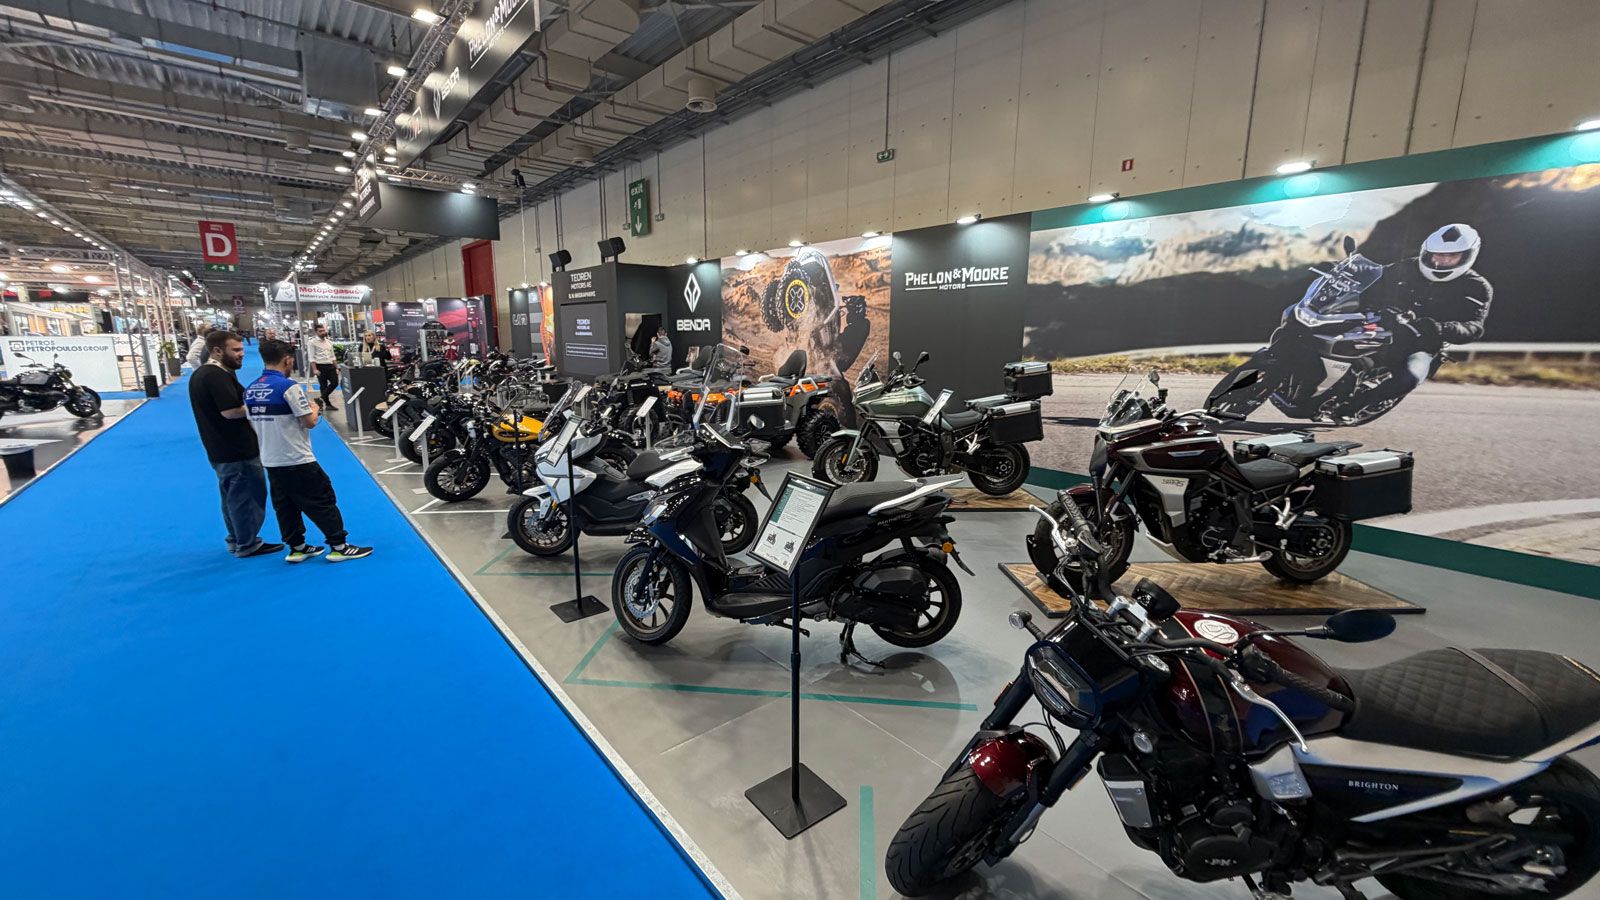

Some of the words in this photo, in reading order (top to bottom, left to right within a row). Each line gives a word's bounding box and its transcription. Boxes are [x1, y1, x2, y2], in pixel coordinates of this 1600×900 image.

[631, 182, 643, 196] exit
[205, 233, 232, 257] D
[570, 271, 592, 282] TEOREN
[299, 286, 360, 295] Motopegasus
[677, 318, 711, 331] BENDA
[1348, 779, 1399, 791] BRIGHTON
